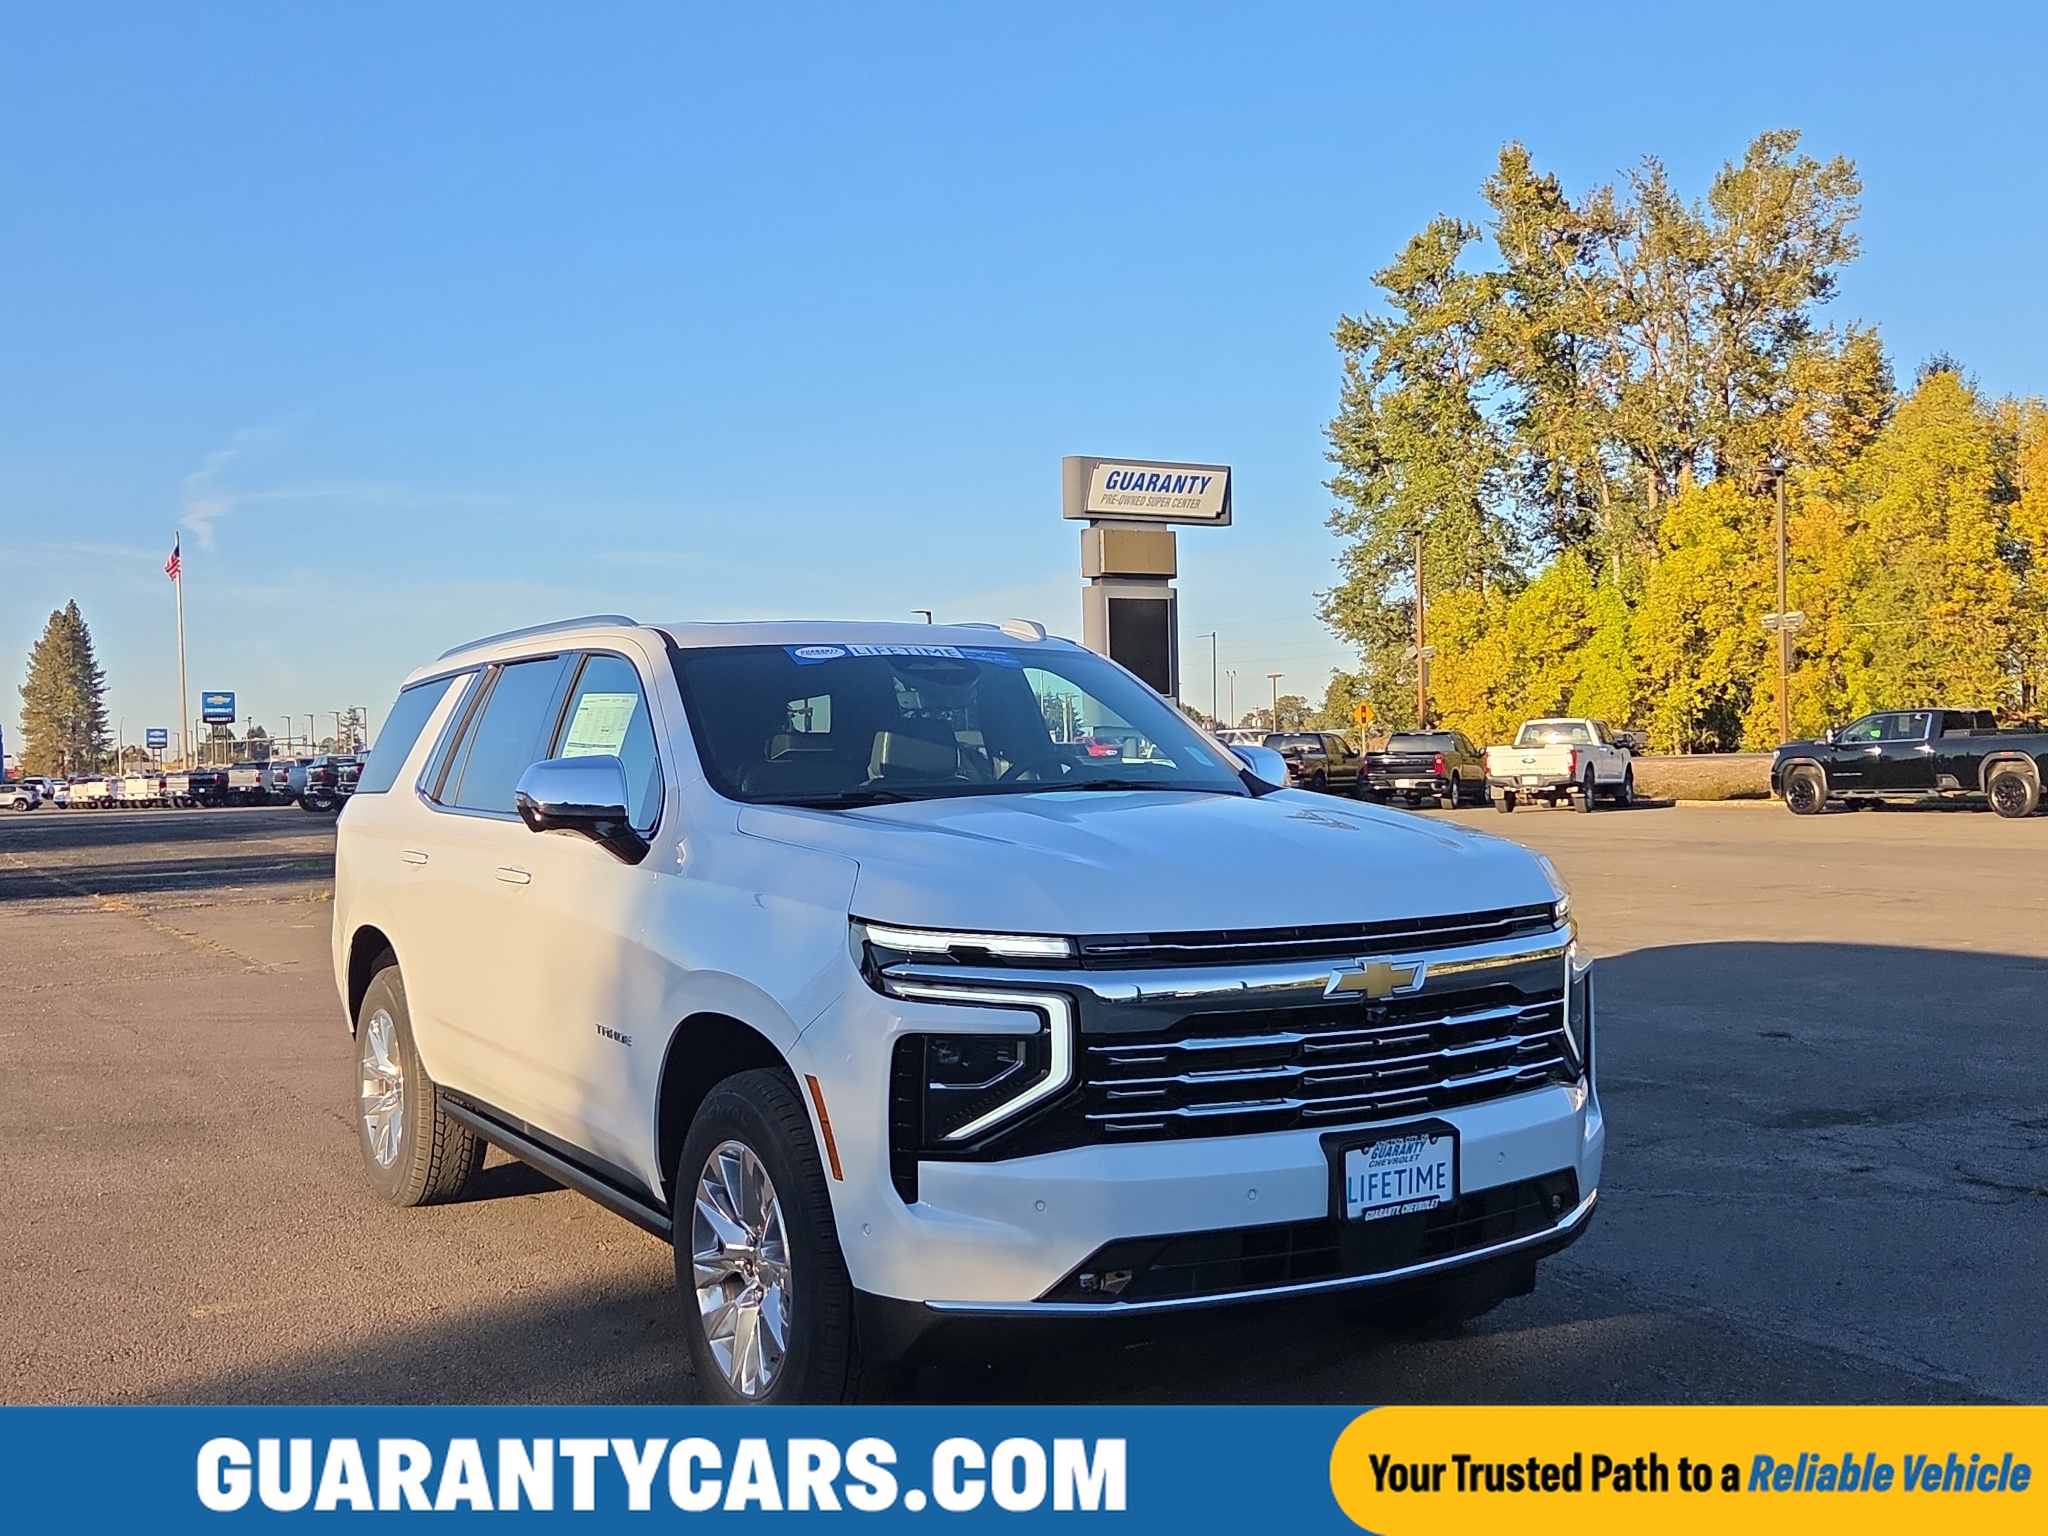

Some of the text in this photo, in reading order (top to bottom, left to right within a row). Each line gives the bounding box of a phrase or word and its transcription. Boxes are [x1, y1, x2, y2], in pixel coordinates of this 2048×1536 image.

[1106, 470, 1213, 495] GUARANTY
[1100, 493, 1202, 510] PRE-OWNED SUPER CENTER
[851, 646, 960, 657] LIFETIME
[1371, 1141, 1426, 1160] GUARANTY
[1368, 1153, 1420, 1168] CHEVROLET
[1347, 1162, 1447, 1204] LIFETIME
[1401, 1198, 1440, 1214] CHEVROLET
